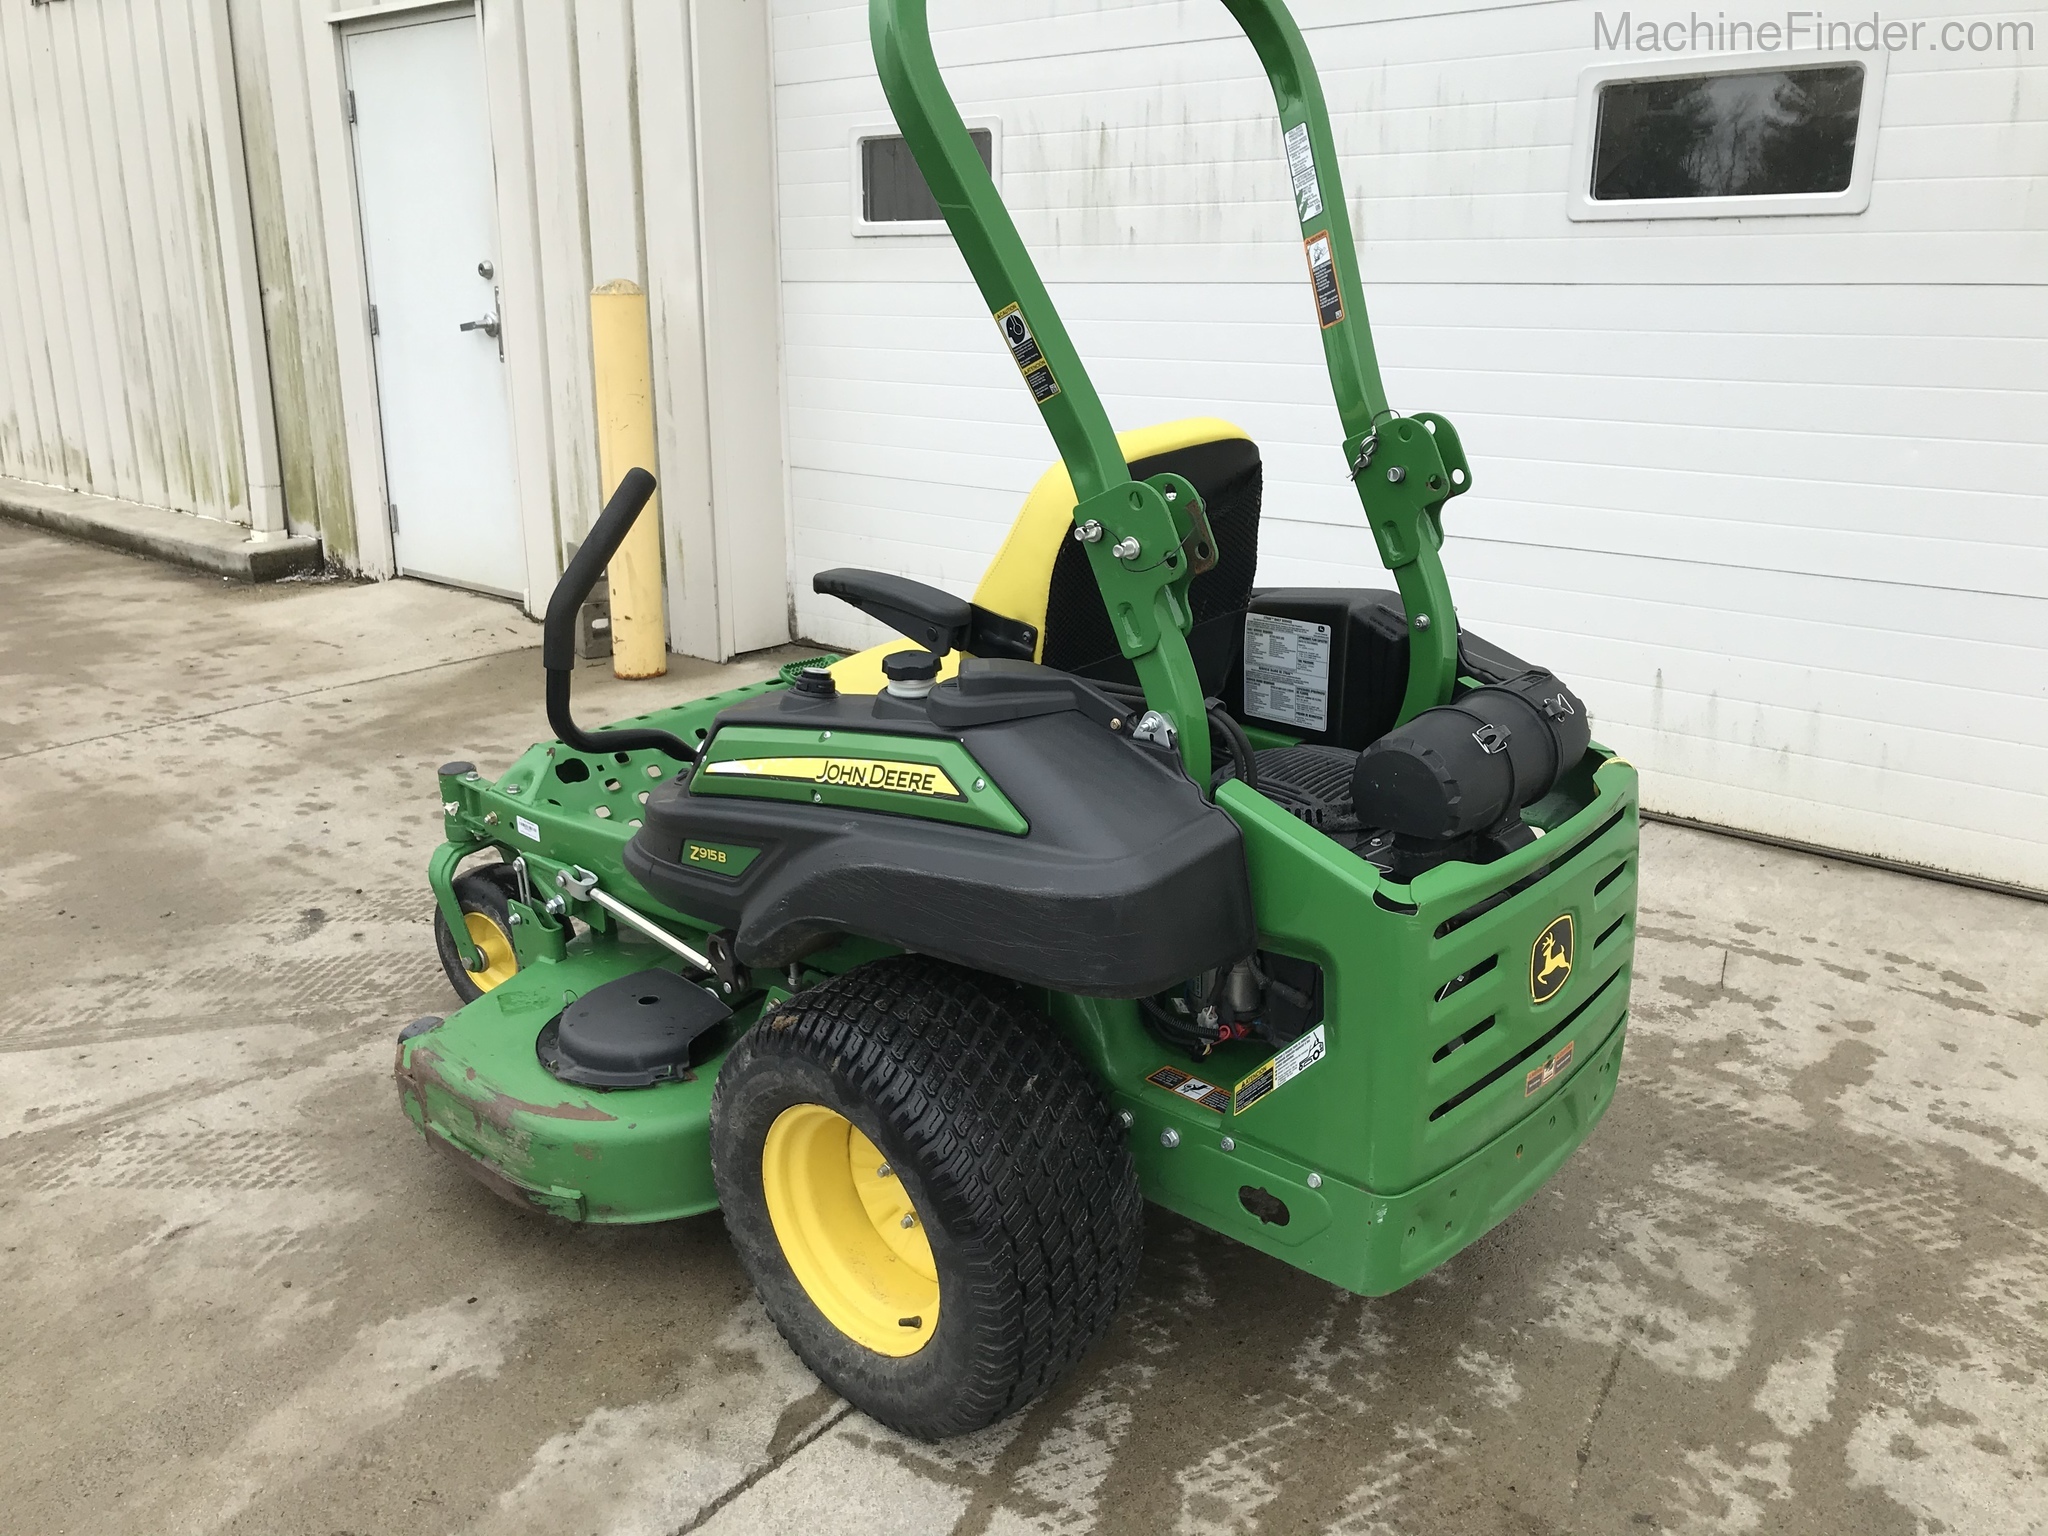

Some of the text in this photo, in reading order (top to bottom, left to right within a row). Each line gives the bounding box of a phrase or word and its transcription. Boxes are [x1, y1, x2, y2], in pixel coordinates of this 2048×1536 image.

[815, 760, 936, 791] JOHN DEERE
[690, 845, 727, 863] Z915B
